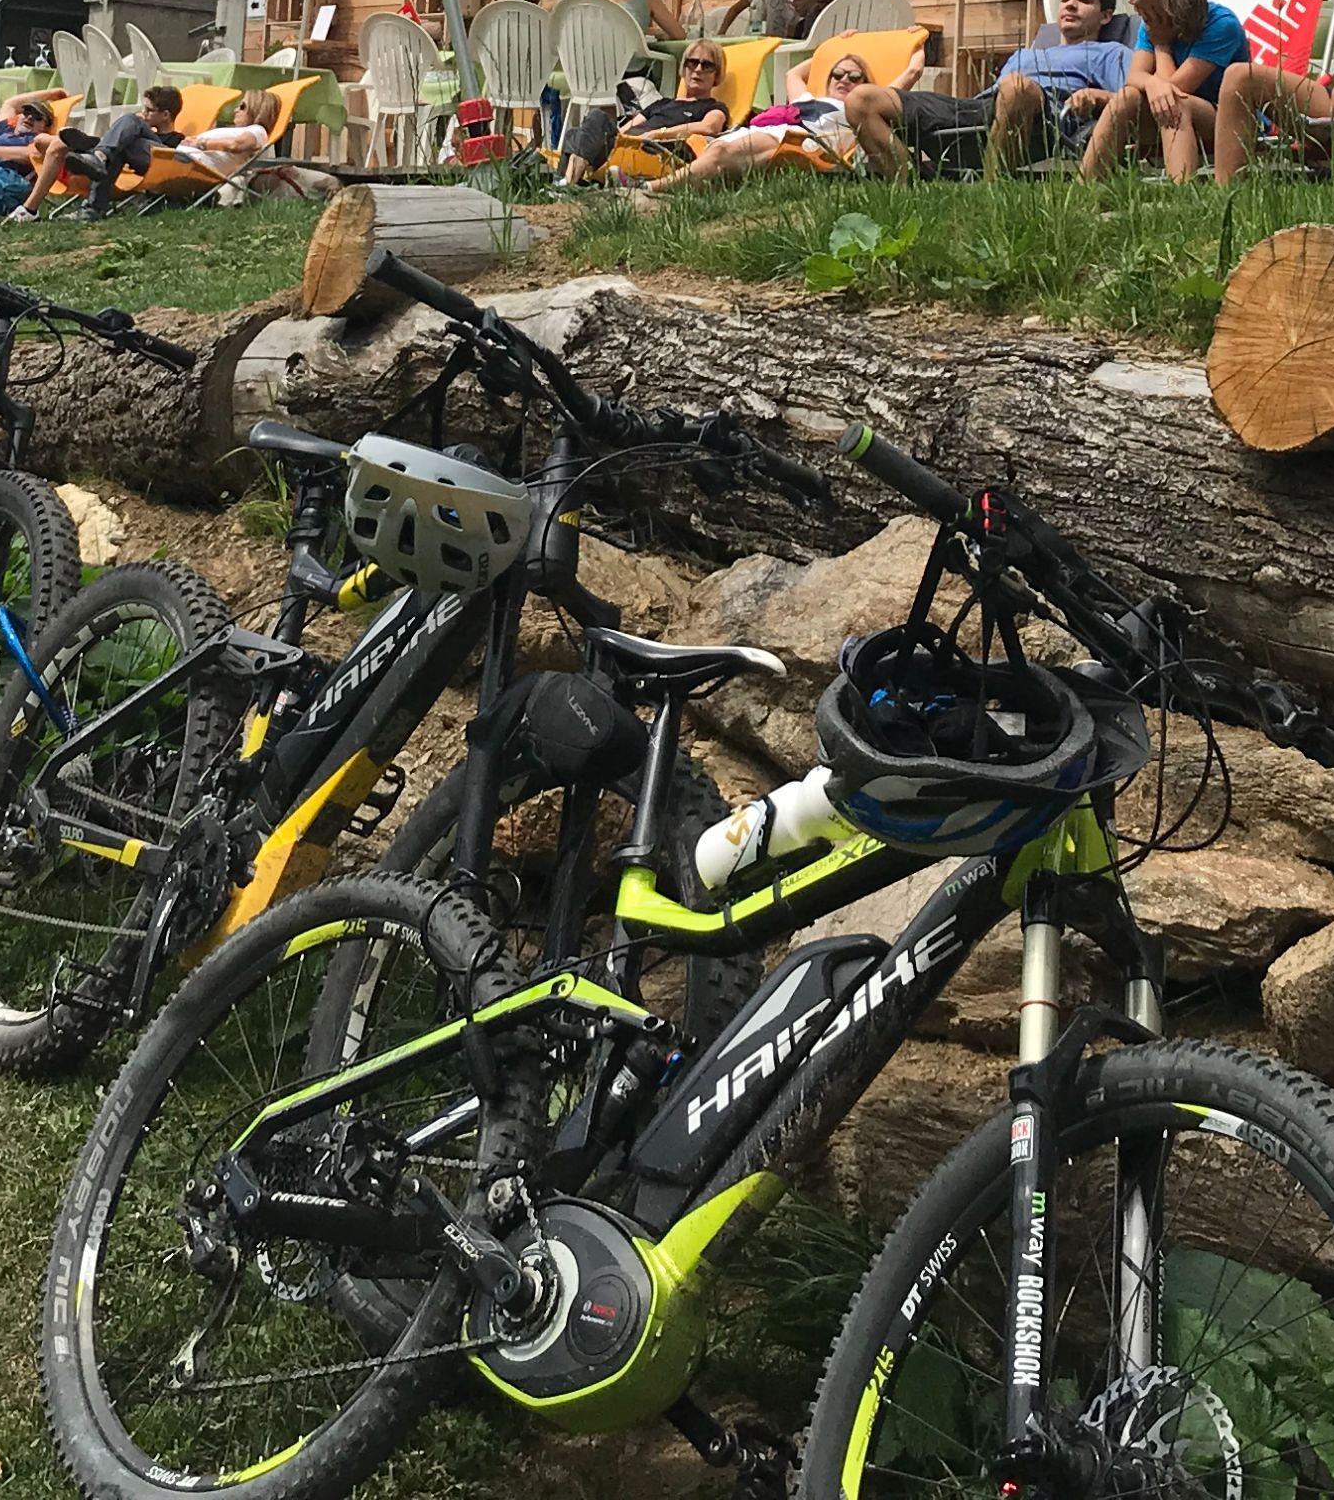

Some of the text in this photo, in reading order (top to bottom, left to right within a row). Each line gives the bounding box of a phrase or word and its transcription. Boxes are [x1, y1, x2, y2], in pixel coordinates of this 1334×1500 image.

[1011, 1120, 1029, 1139] OCK
[1011, 1139, 1029, 1159] HOX
[900, 1232, 958, 1322] DT SWISS
[1013, 1273, 1045, 1387] ROCKSHOX
